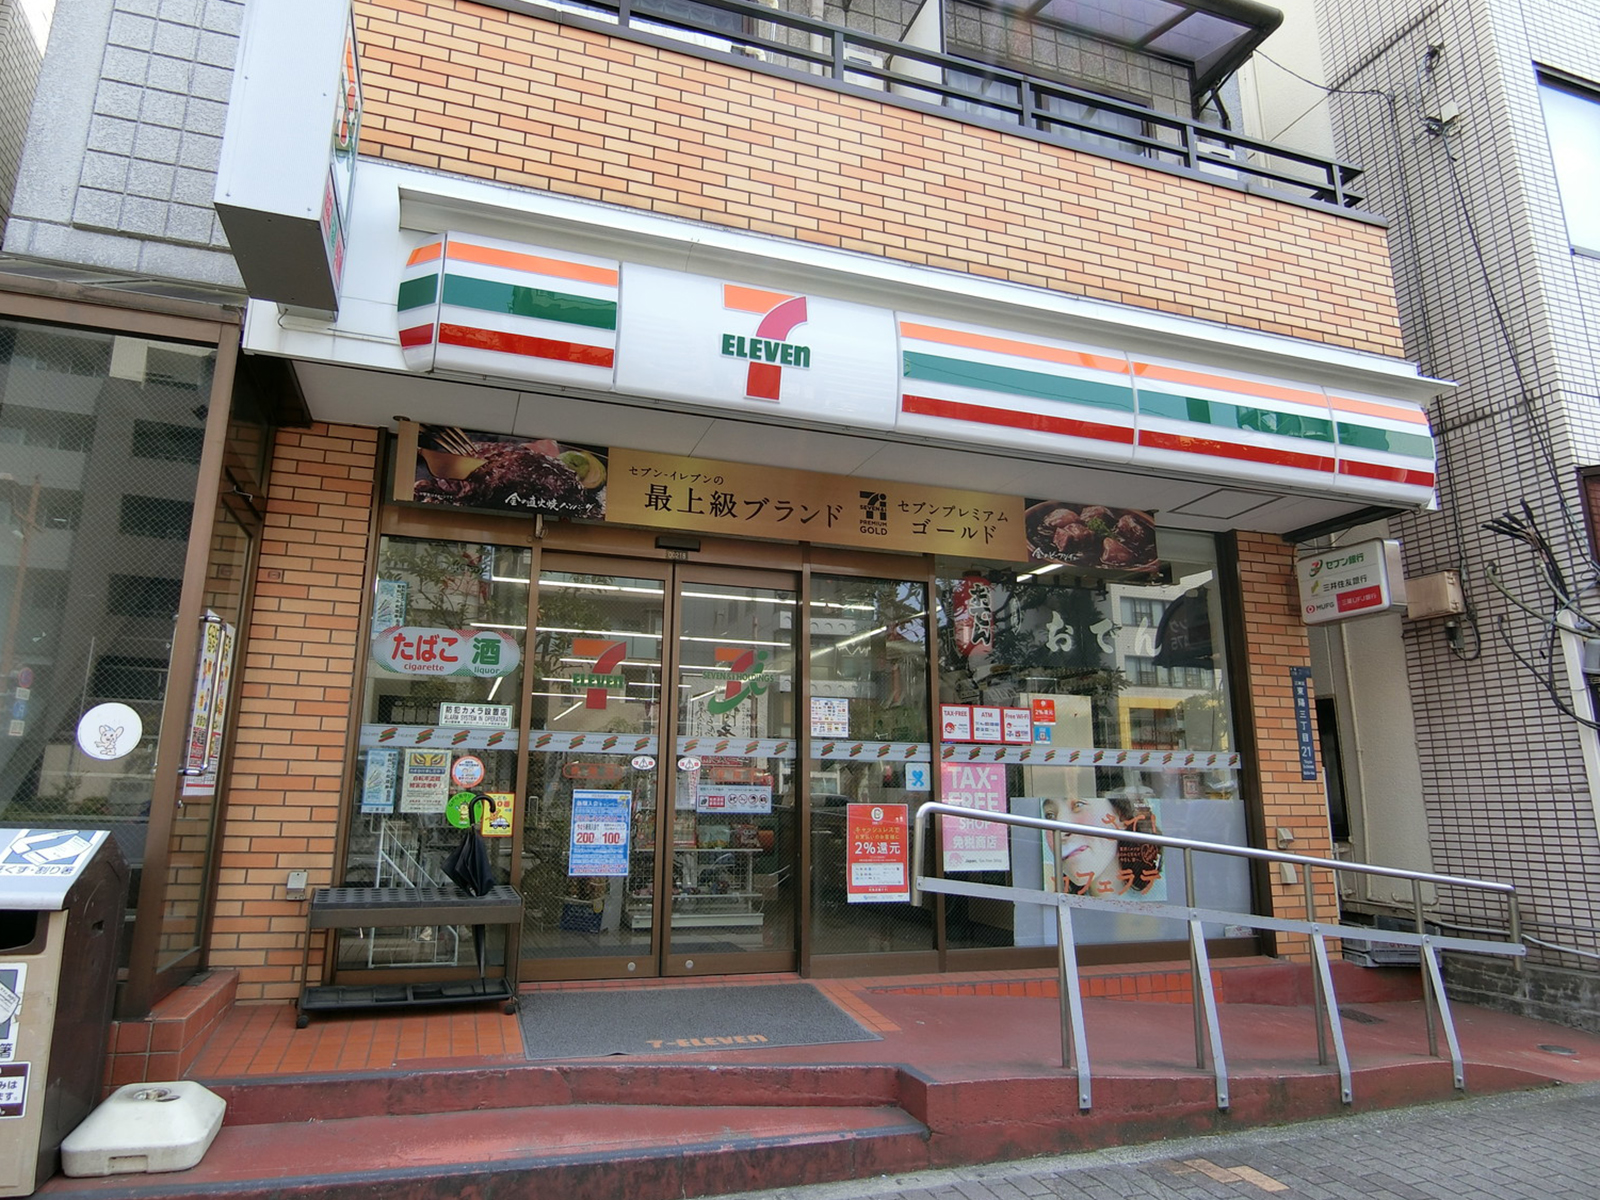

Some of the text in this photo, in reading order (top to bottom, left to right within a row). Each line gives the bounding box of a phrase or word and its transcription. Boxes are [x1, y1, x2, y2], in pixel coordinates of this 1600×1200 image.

[644, 483, 843, 528] 最上級ブランド
[898, 499, 1009, 523] セブンプレミアム
[859, 519, 888, 527] PREMIUM
[859, 526, 888, 536] GOLD
[912, 518, 997, 545] ゴールド
[1325, 552, 1365, 570] セブン銀行
[1322, 574, 1368, 592] 三井住友銀行
[1315, 602, 1335, 611] MUFG
[1045, 610, 1161, 657] おでん
[391, 632, 501, 666] たばこ 酒
[403, 664, 501, 675] cigarette liquor
[445, 705, 508, 717] 防犯カメラ設置店
[1296, 686, 1310, 743] 東陽三丁目
[1301, 746, 1312, 758] 21
[947, 766, 998, 790] TAX-
[959, 817, 992, 830] SHOP
[576, 832, 620, 844] 200 100
[854, 841, 901, 855] 2%還元
